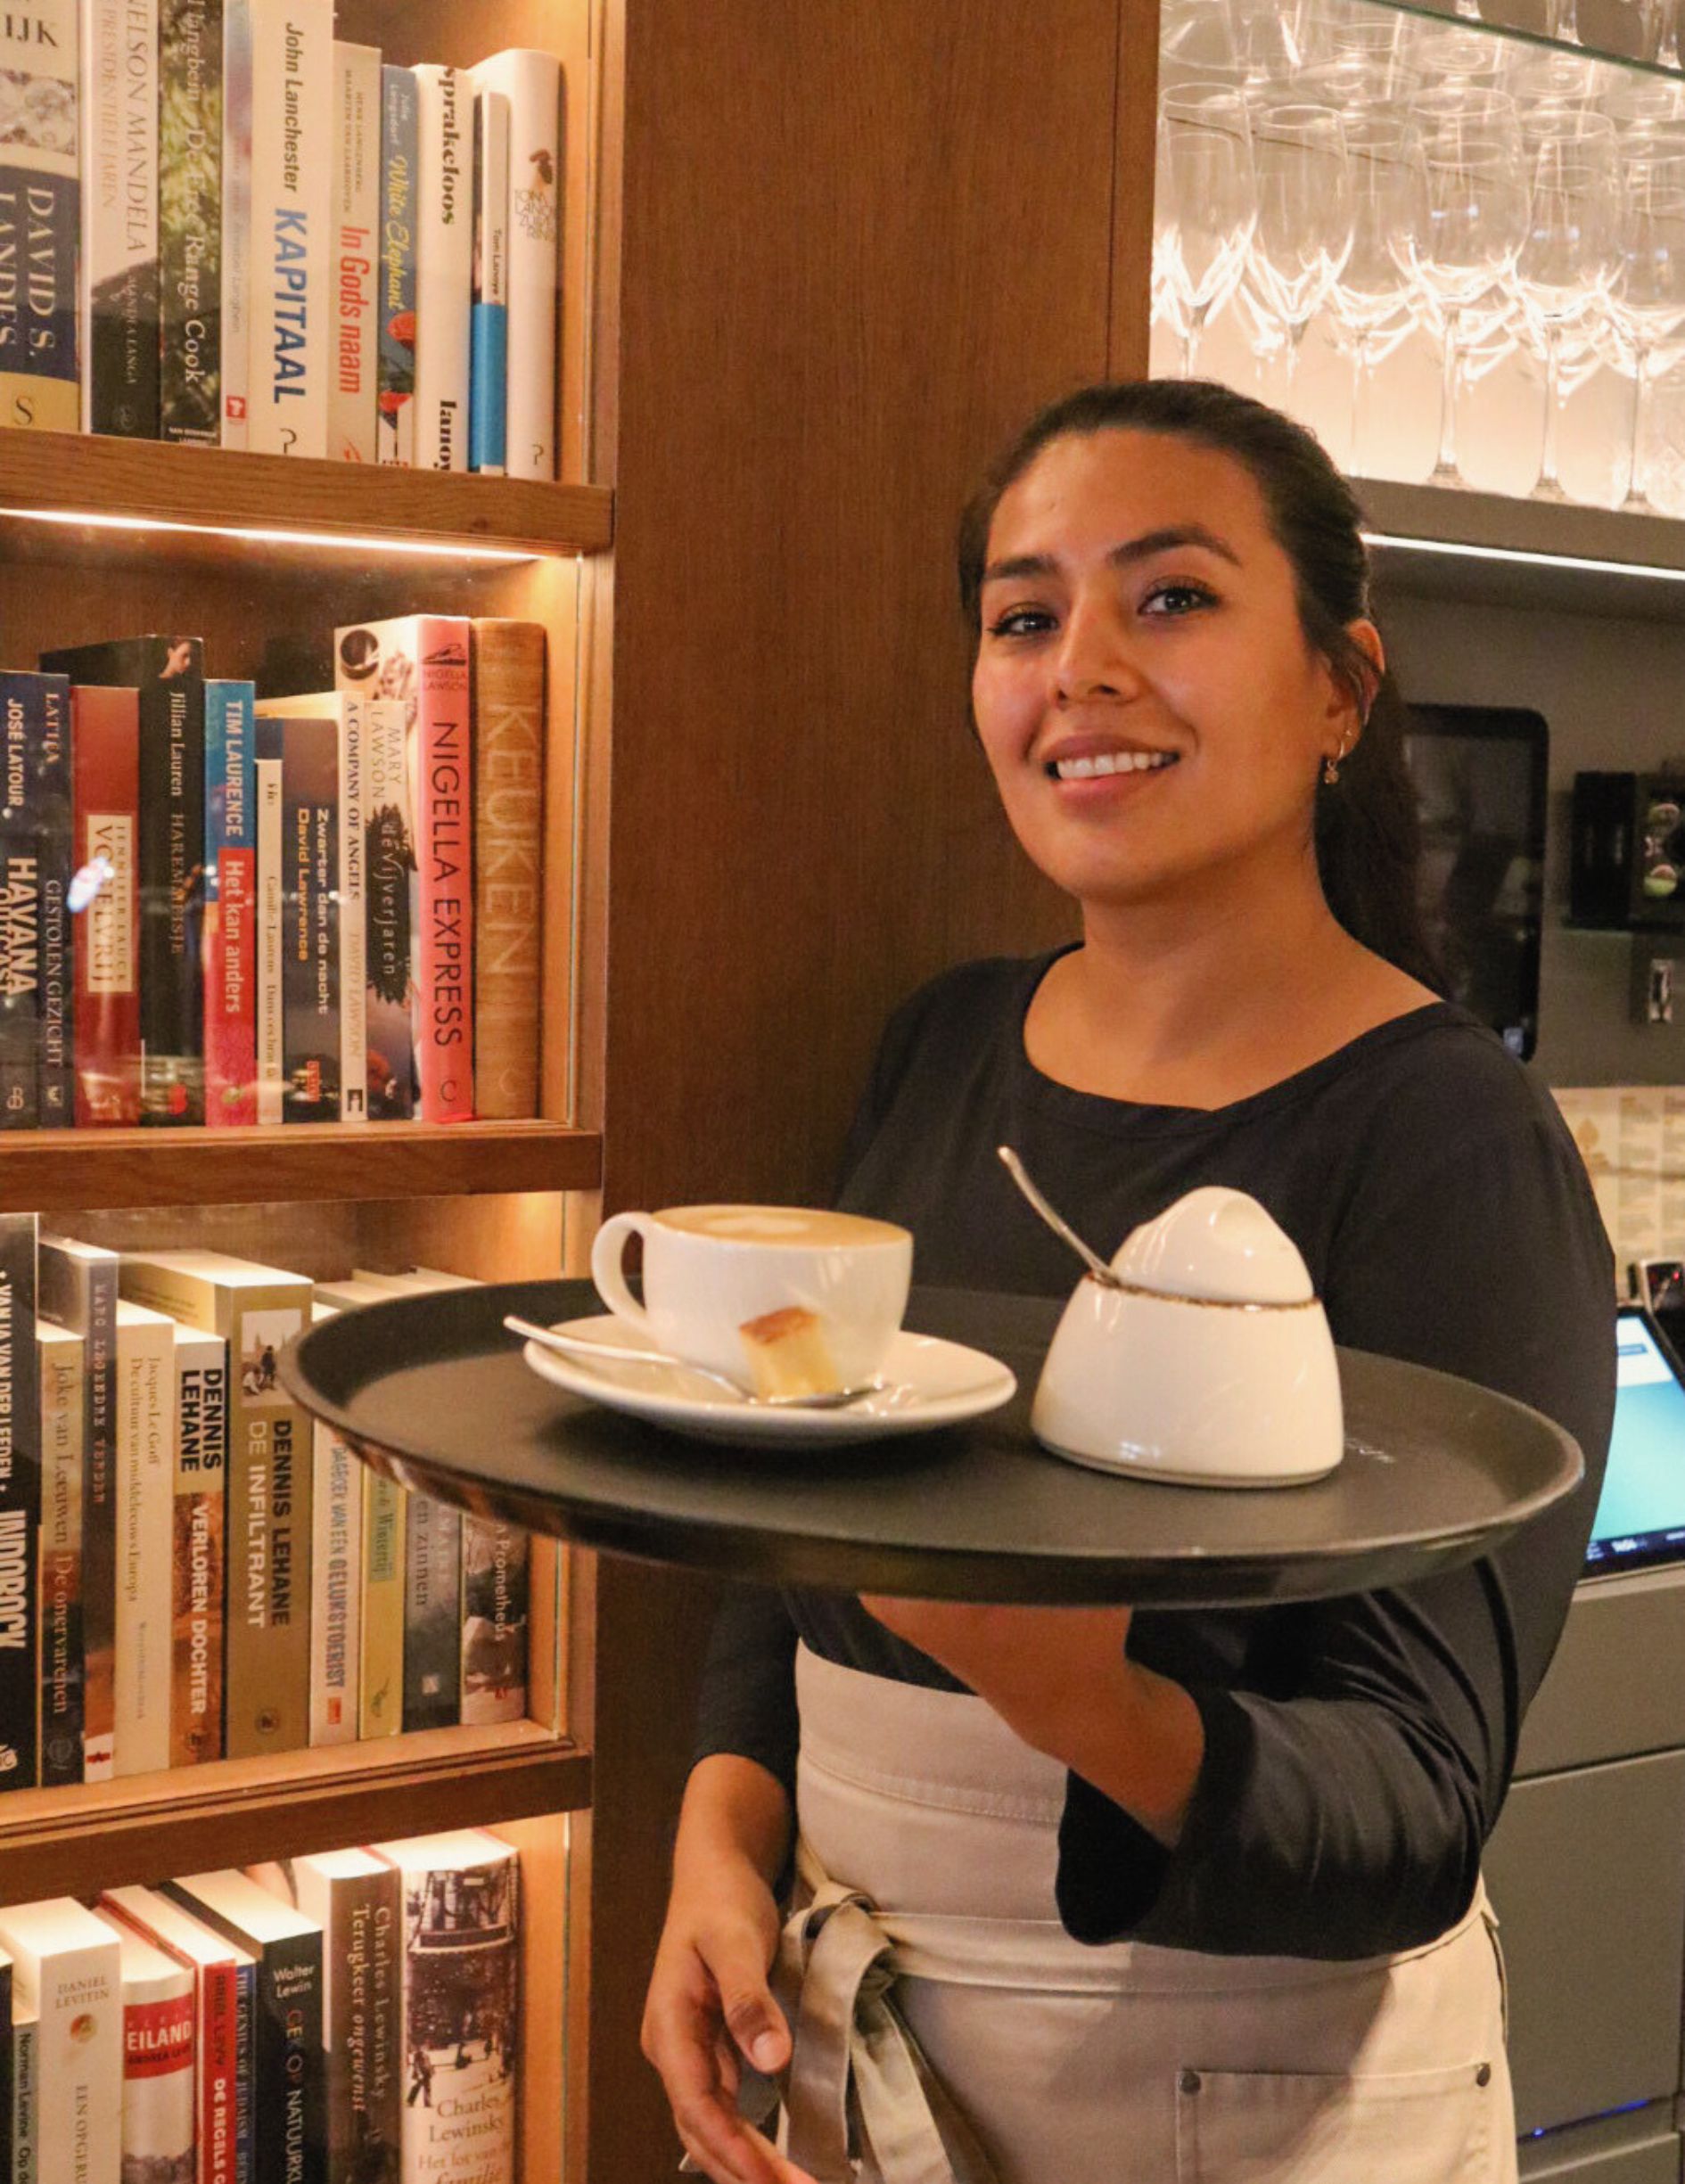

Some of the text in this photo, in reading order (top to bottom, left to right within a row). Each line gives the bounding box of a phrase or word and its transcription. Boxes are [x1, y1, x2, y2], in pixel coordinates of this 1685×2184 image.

[127, 111, 149, 252] MANDELA
[184, 129, 206, 161] De
[438, 68, 461, 226] sprakeloos
[273, 23, 308, 405] John Lanchester KAPITAAL
[382, 155, 411, 311] White Elephant
[490, 228, 503, 295] Tom Lanoye
[28, 186, 55, 357] DAVID S.
[177, 234, 206, 310] Range
[339, 226, 371, 393] In Gods naam
[184, 319, 206, 384] Cook
[7, 698, 28, 807] JOSÉ LATOUR
[168, 692, 186, 739] Jillian
[370, 710, 386, 800] LAWSON
[386, 727, 402, 785] MARY
[169, 743, 186, 797] Lauren
[224, 699, 244, 837] TIM LAURENCE
[346, 701, 360, 901] A COMPANY OF ANGELS
[297, 808, 311, 962] David Lawrence
[432, 721, 462, 1047] NIGELLA EXPRESS
[484, 702, 540, 973] KEUKEN
[8, 857, 38, 997] HAVANA
[225, 859, 244, 1014] Het kan anders
[316, 808, 331, 1015] Zwarter dan de nacht
[45, 879, 63, 1067] GESTOLEN GEZICHT
[53, 1363, 75, 1406] Joke
[59, 1413, 71, 1447] van
[148, 1411, 160, 1429] Le
[181, 1369, 201, 1474] LEHANE
[202, 1368, 224, 1470] DENNIS
[147, 1432, 161, 1466] Goff
[55, 1454, 74, 1544] Leeuwen
[248, 1420, 267, 1630] DE INFILTRANT
[272, 1419, 293, 1627] DENNIS LEHANE
[331, 1504, 348, 1531] VAN
[54, 1555, 74, 1582] De
[190, 1504, 210, 1714] VERLOREN DOCHTER
[415, 1533, 435, 1606] zinnen
[494, 1539, 512, 1642] Prometheus
[55, 1989, 111, 2009] LEVITIN
[57, 1975, 107, 1995] DANIEL
[347, 1903, 369, 2112] Terugkeer ongewenst
[370, 1906, 392, 2098] Charles Lewinsky
[18, 2032, 32, 2090] Norman
[127, 2020, 193, 2052] EILAND
[18, 2092, 32, 2138] Levine
[213, 2106, 227, 2171] REGELS
[214, 2077, 226, 2104] DE
[17, 2147, 31, 2168] Op
